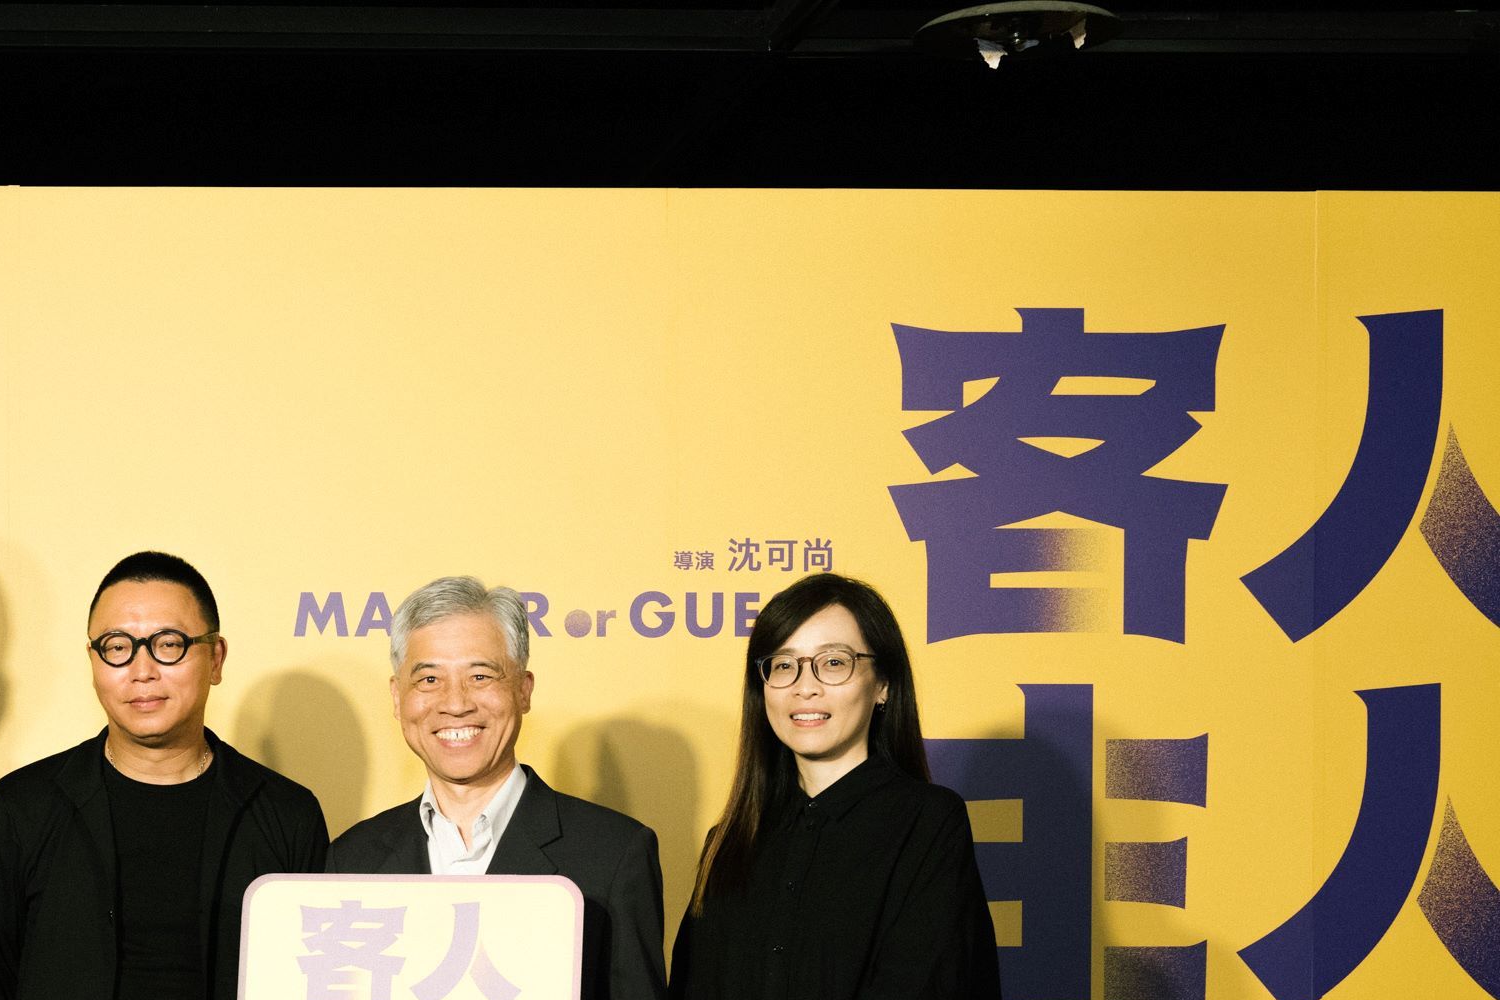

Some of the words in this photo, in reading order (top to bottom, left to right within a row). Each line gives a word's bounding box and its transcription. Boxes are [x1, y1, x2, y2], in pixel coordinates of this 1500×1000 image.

[674, 550, 715, 571] 導演
[728, 537, 833, 572] 沈可尚
[294, 592, 552, 637] MAR
[630, 590, 762, 638] GUE
